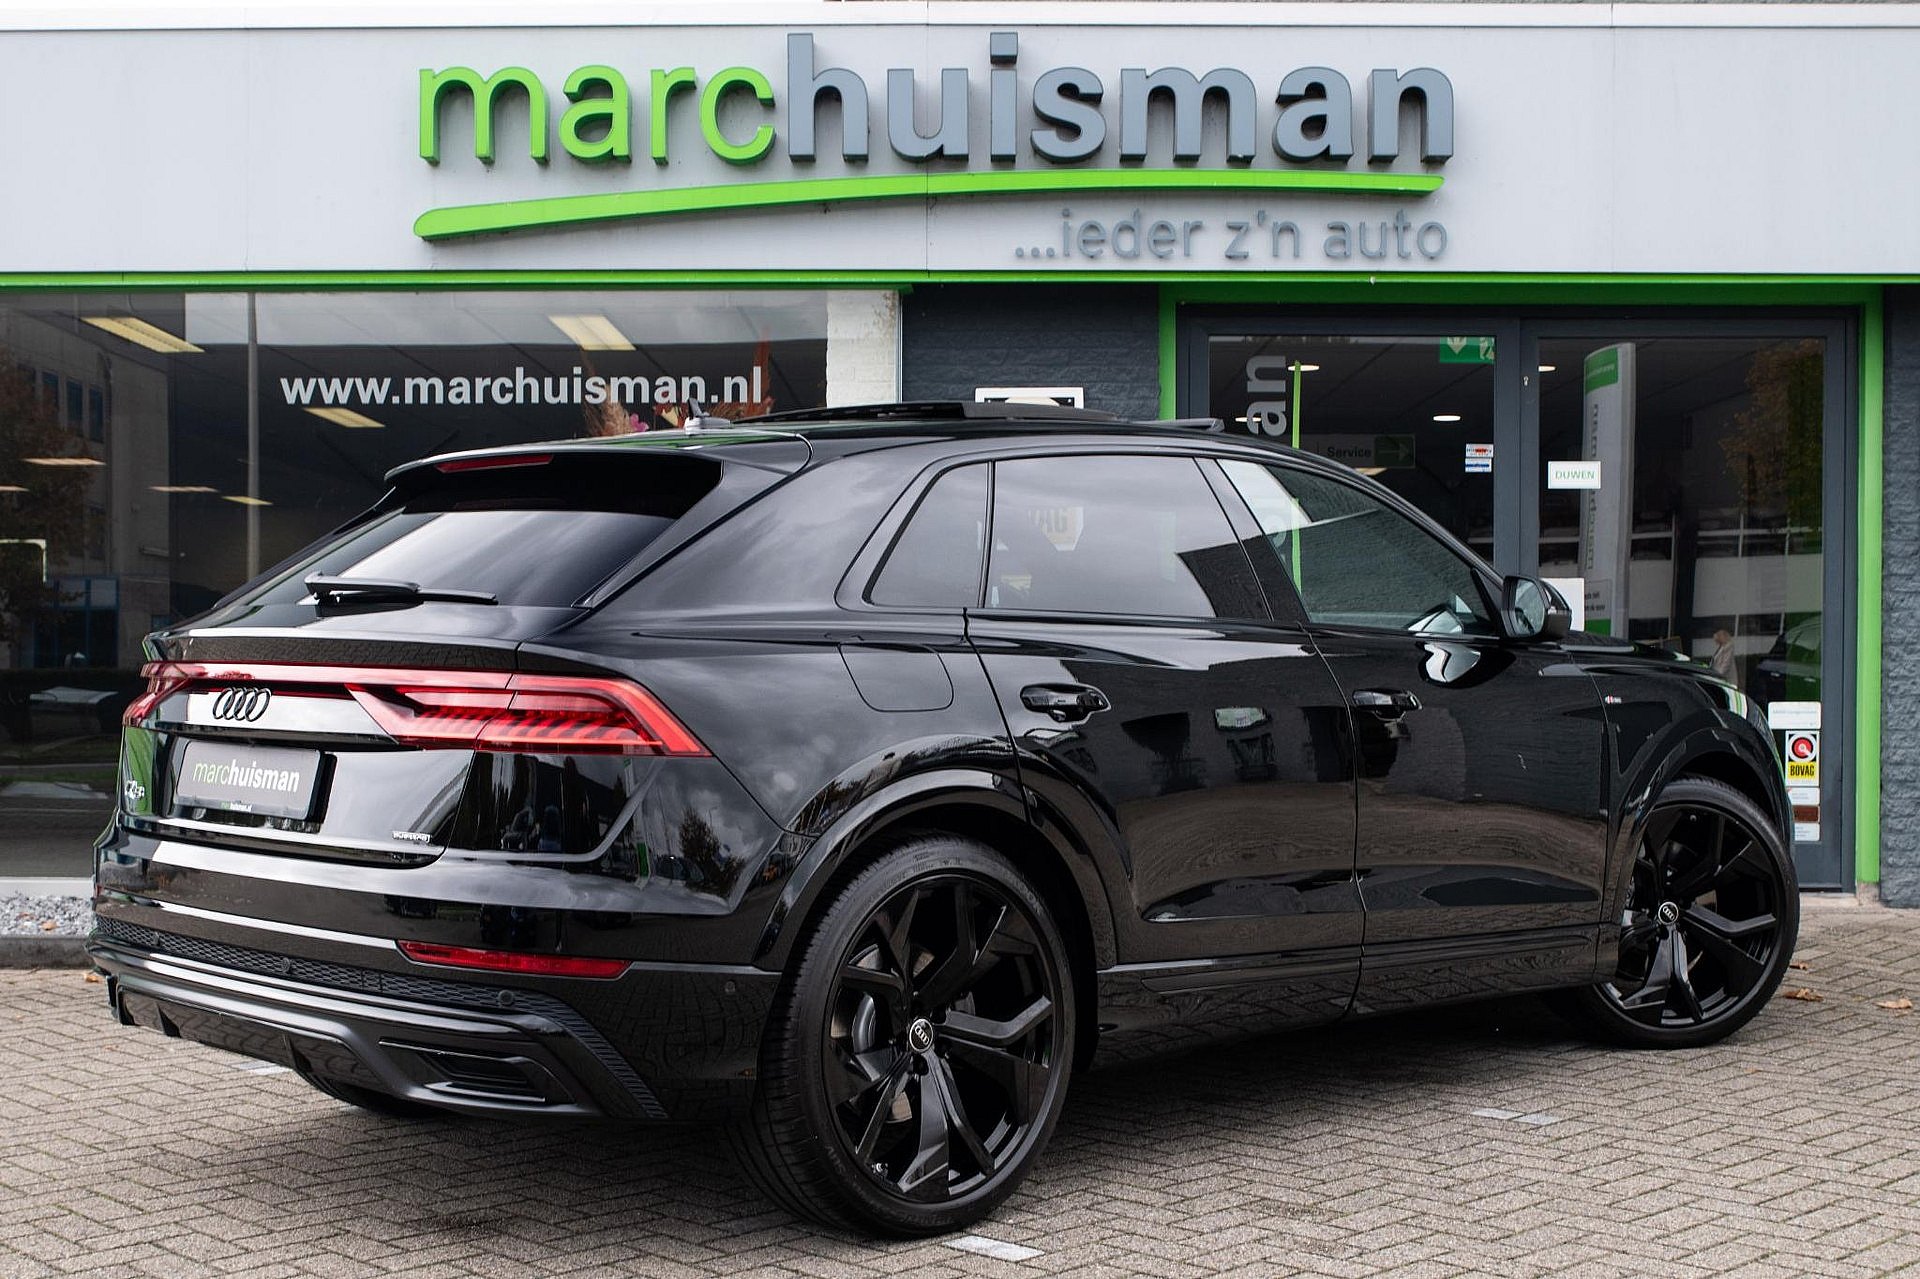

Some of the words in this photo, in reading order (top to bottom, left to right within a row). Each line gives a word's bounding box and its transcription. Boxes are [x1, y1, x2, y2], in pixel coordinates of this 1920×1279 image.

[418, 32, 1455, 165] marchuisman
[1224, 209, 1301, 259] z'n
[1323, 208, 1448, 259] auto
[279, 366, 764, 406] www.marchuisman.nl
[1326, 446, 1372, 459] Service
[1555, 469, 1595, 480] DUWEN
[193, 759, 299, 793] marchuisman
[1789, 763, 1815, 777] BOVAG
